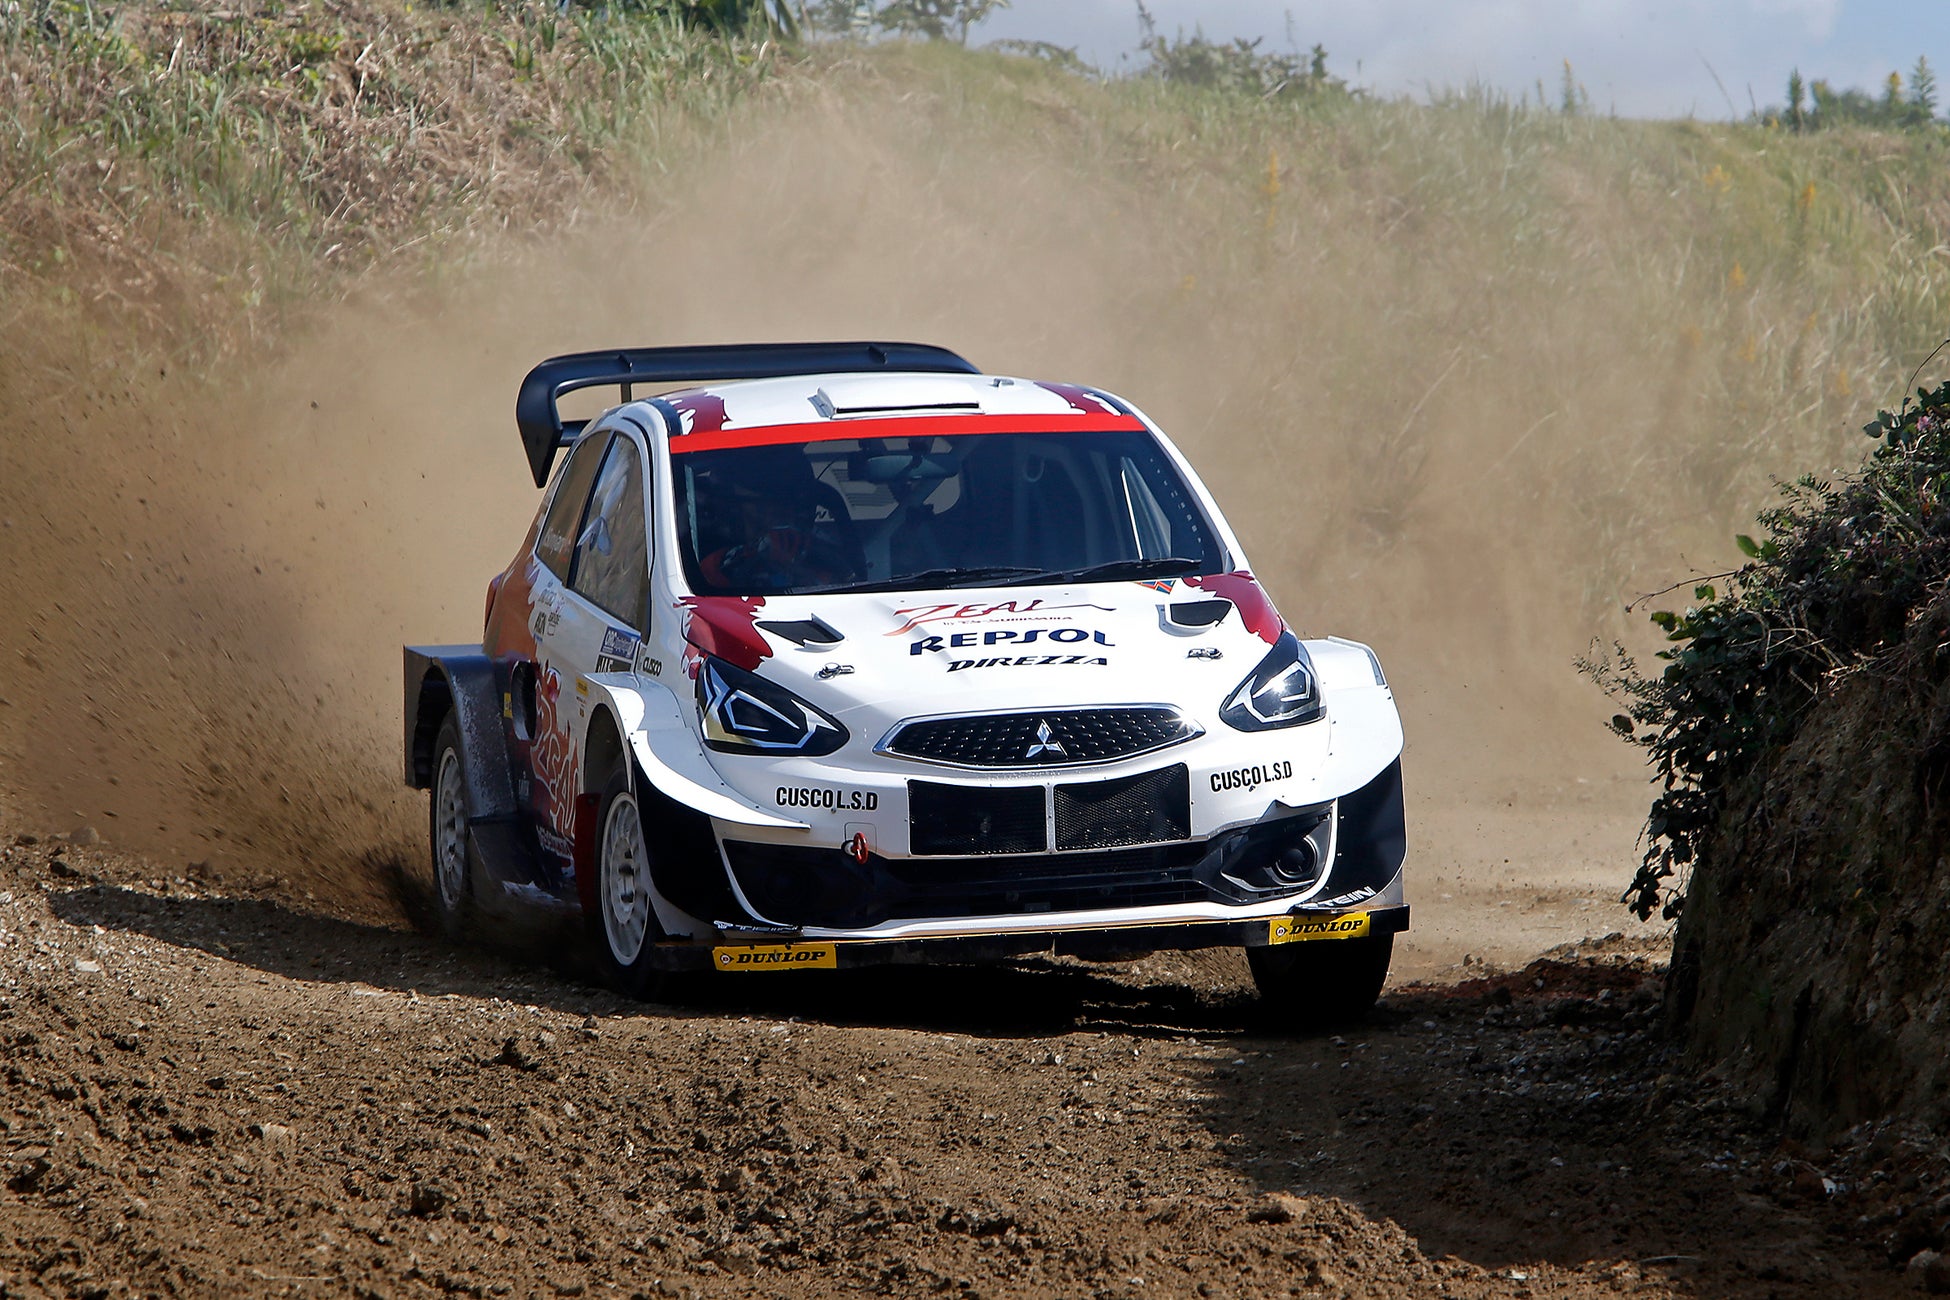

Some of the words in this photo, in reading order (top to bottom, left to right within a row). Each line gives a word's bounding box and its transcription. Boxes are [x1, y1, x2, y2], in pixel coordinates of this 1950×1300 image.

[883, 599, 1117, 636] ZEAL
[910, 628, 1116, 656] REPSOL
[947, 655, 1108, 673] DIREZZA
[1210, 766, 1261, 793] CUSCO
[1262, 760, 1293, 783] L.S.D
[775, 786, 834, 809] CUSCO
[836, 790, 878, 811] L.S.D
[1289, 919, 1364, 934] DUNLOP
[736, 951, 827, 964] DUNLOP
